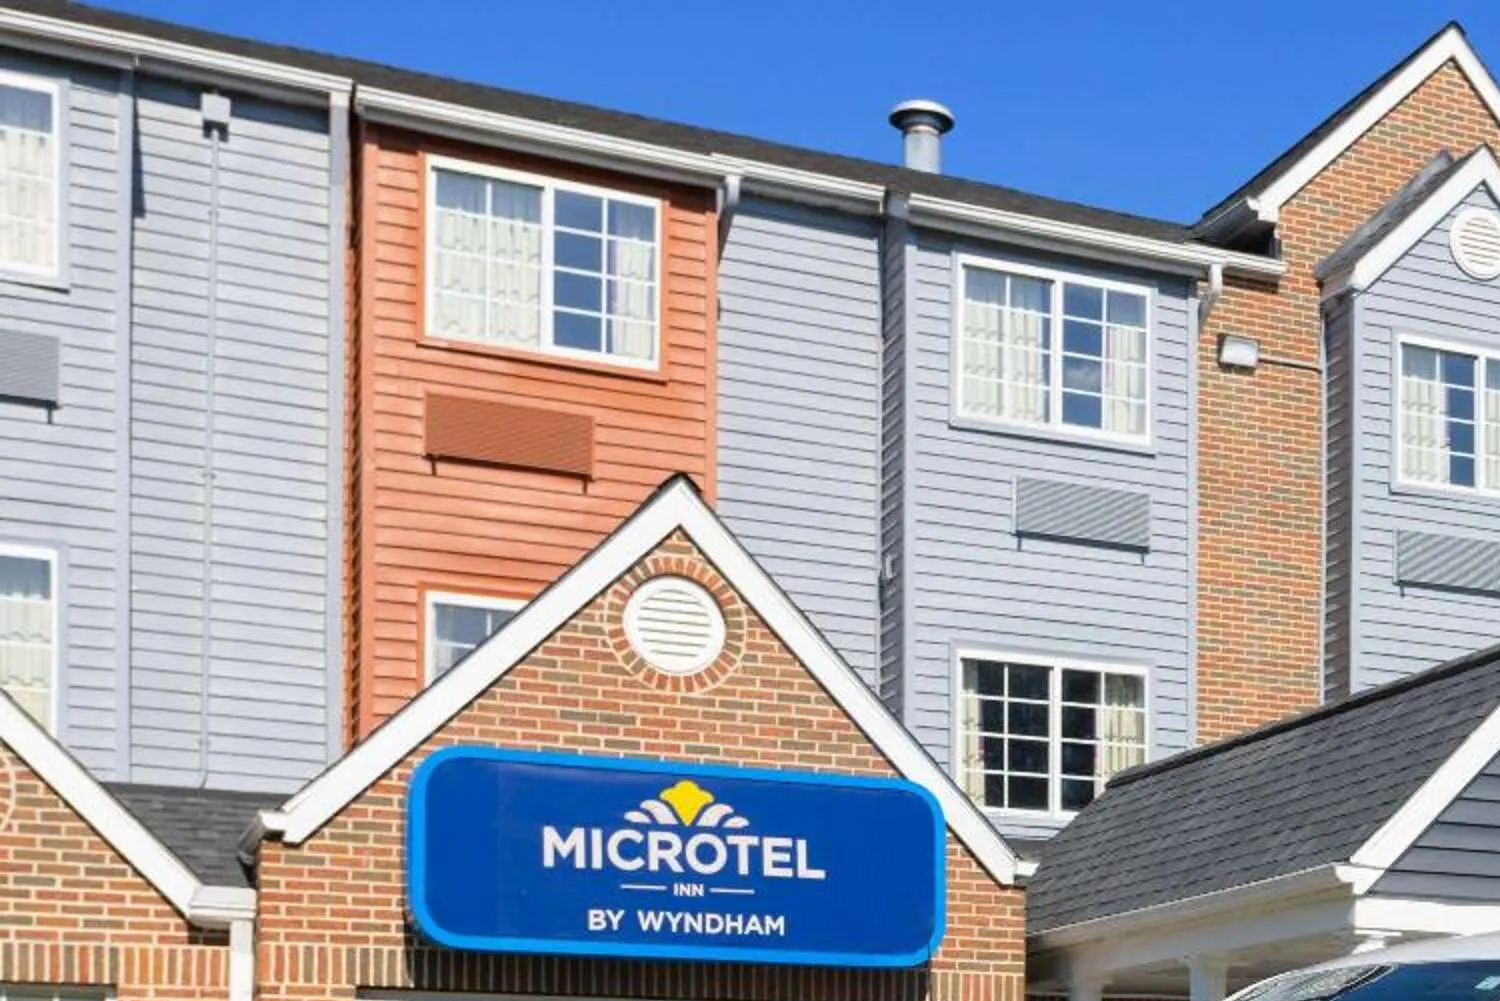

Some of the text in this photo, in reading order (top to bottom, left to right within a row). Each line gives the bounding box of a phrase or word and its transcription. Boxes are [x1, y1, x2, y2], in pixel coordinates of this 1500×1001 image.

[542, 825, 826, 880] MICROTEL
[673, 882, 704, 897] INN
[587, 909, 785, 936] BY WYNDHAM
